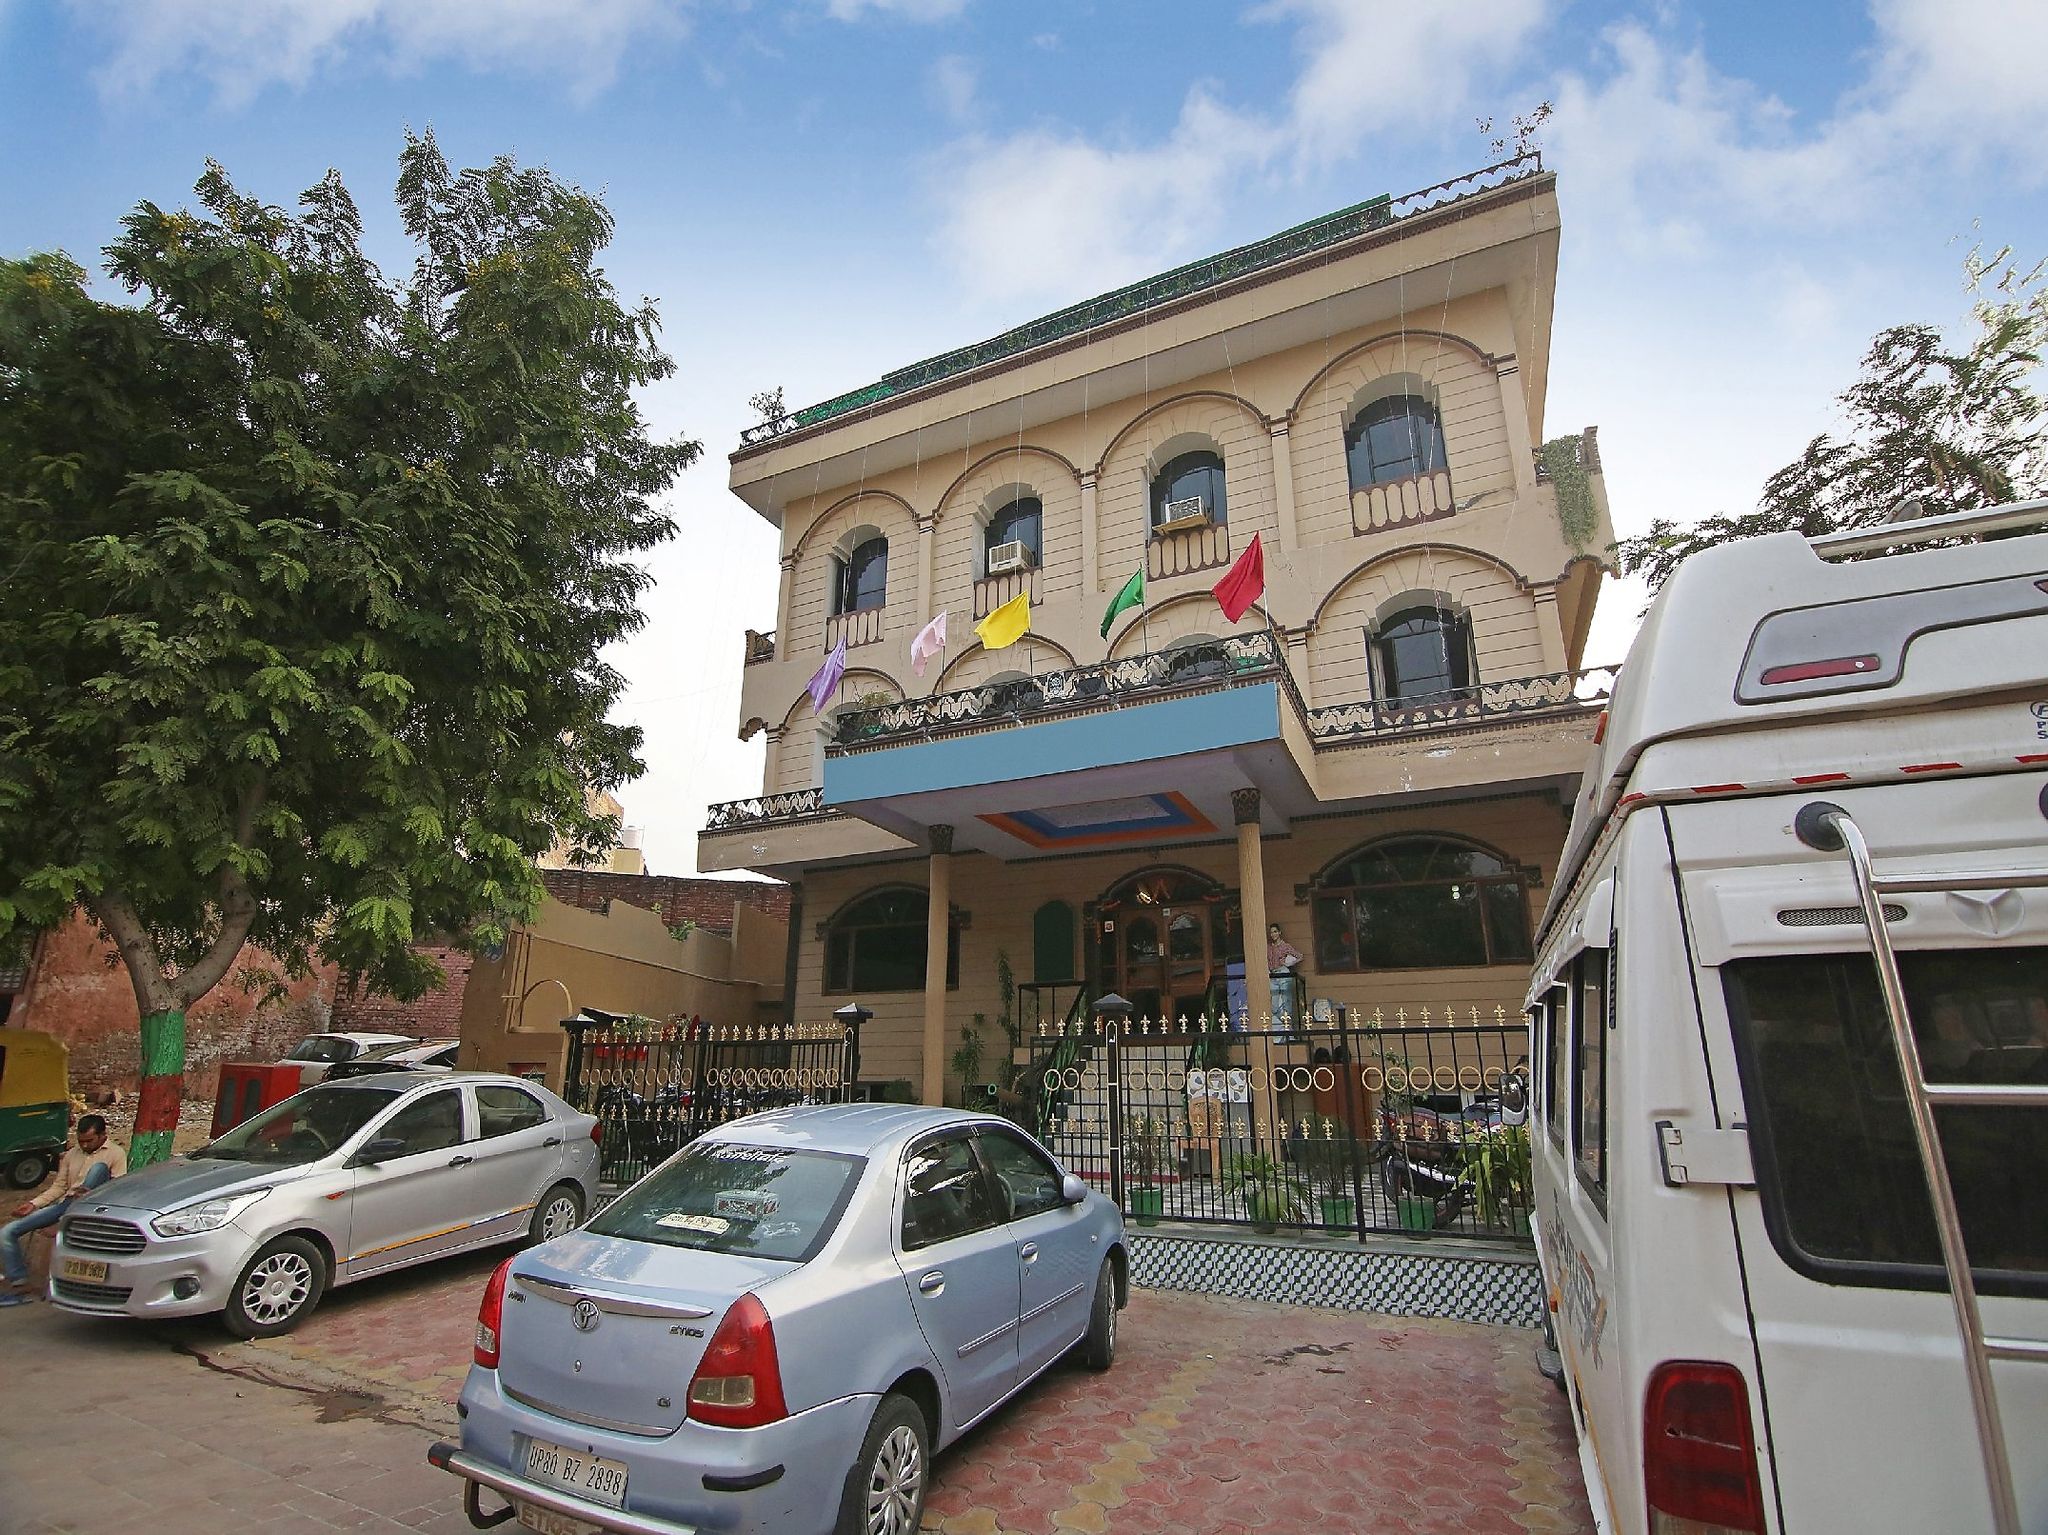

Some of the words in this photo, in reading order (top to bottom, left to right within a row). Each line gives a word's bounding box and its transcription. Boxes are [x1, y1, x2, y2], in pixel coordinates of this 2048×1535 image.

[669, 1324, 705, 1338] ETIOS
[529, 1445, 559, 1476] UP80
[562, 1456, 582, 1482] BZ
[586, 1464, 622, 1496] 2898
